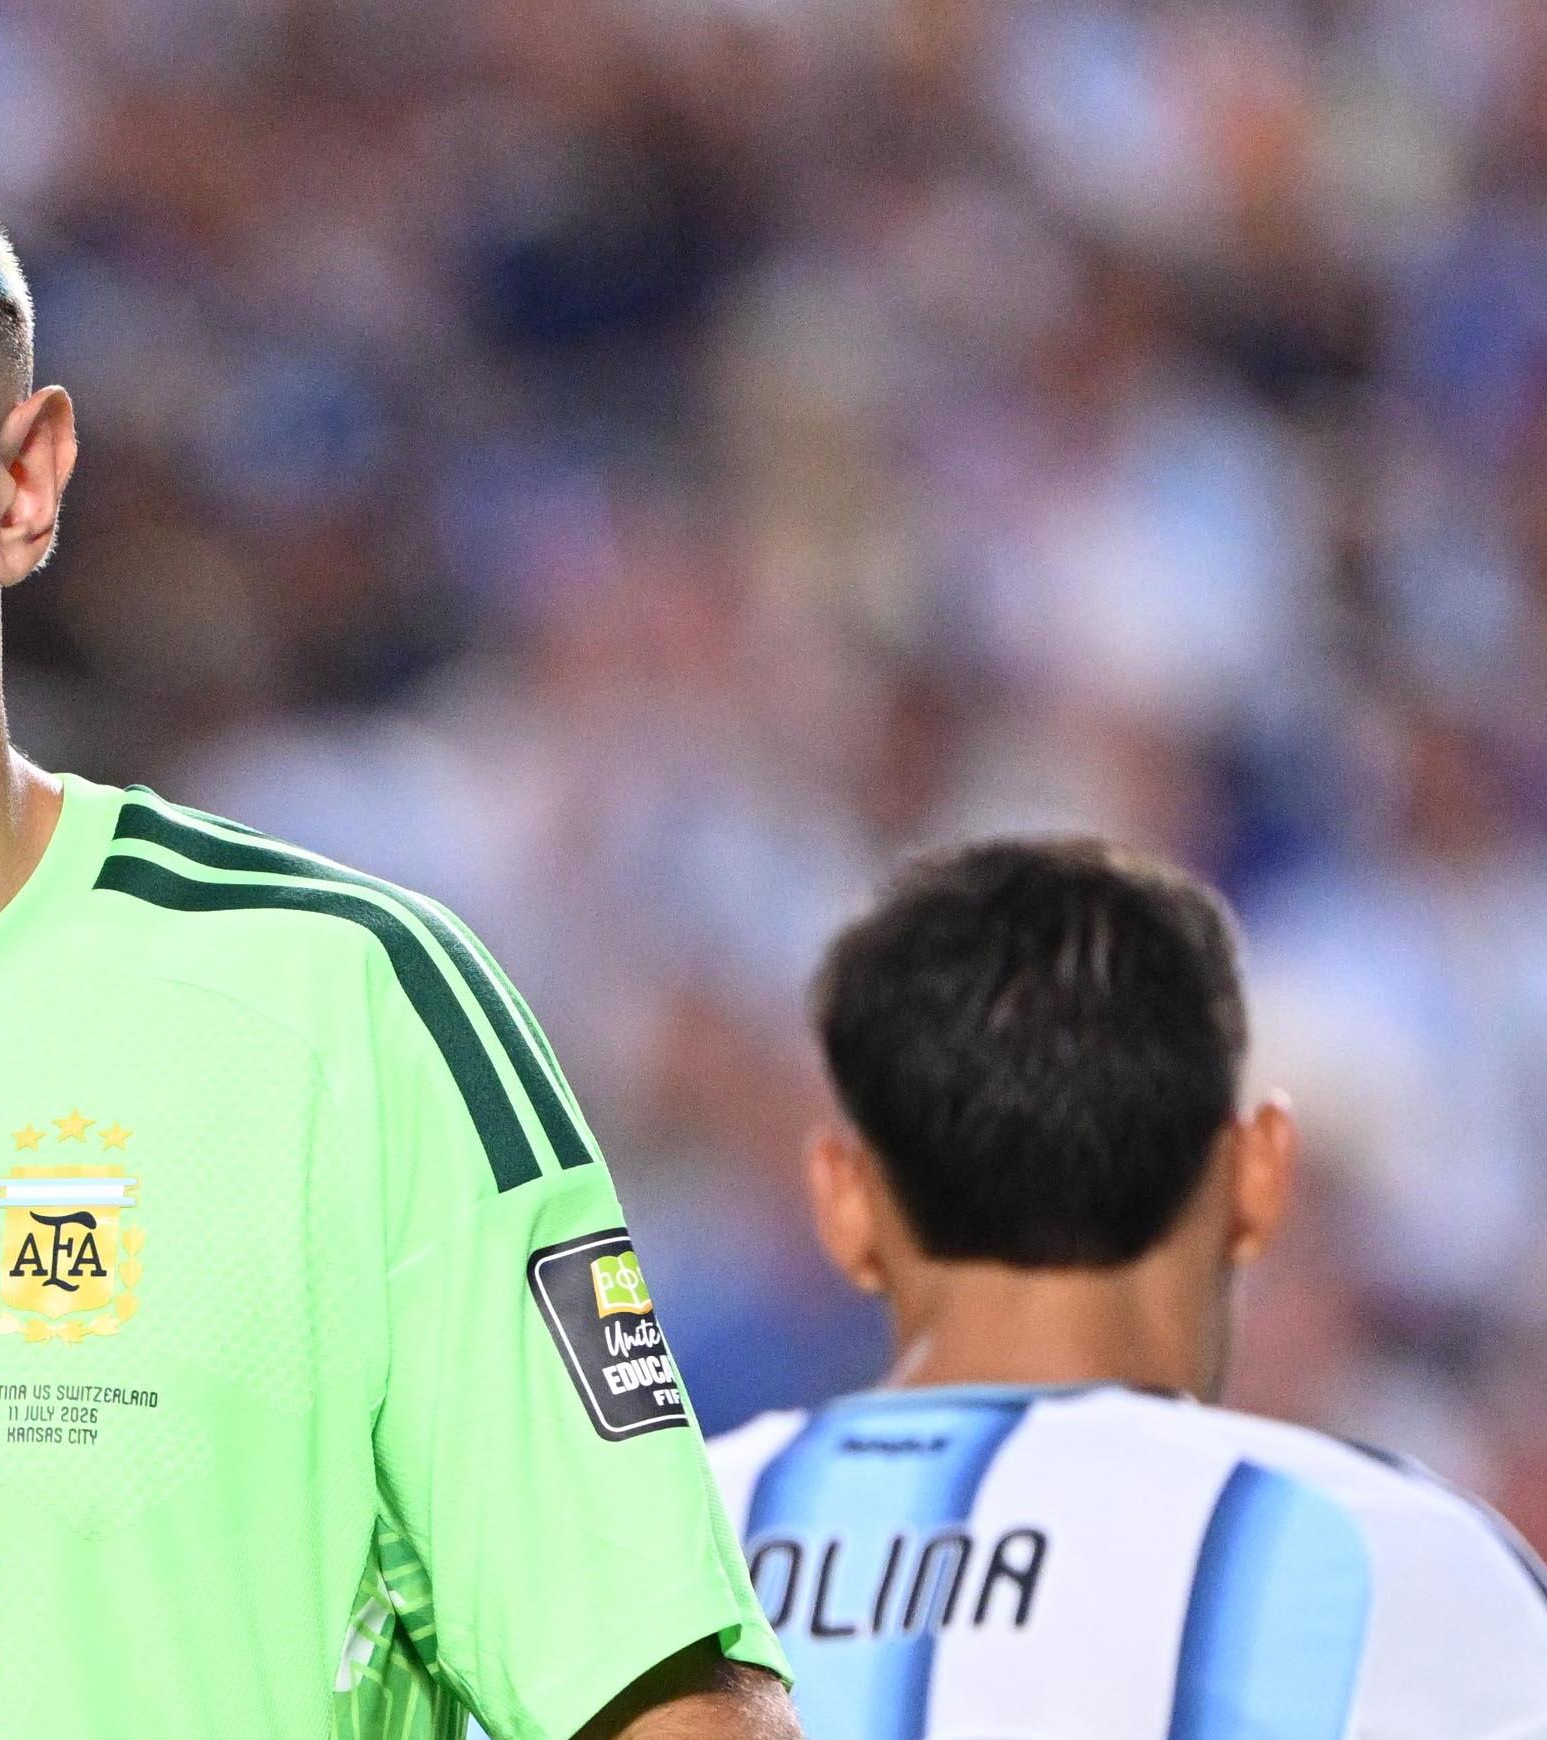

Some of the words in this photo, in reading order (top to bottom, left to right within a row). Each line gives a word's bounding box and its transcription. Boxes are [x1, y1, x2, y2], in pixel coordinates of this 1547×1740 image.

[9, 1211, 107, 1292] AFA
[605, 1319, 661, 1358] Unite
[56, 1385, 159, 1408] SWITZERLAND
[8, 1406, 19, 1422] 11
[24, 1405, 55, 1422] JULY
[60, 1406, 98, 1424] 2026
[7, 1427, 63, 1444] KANSAS
[68, 1428, 97, 1445] CITY
[750, 1528, 1048, 1638] OLINA
